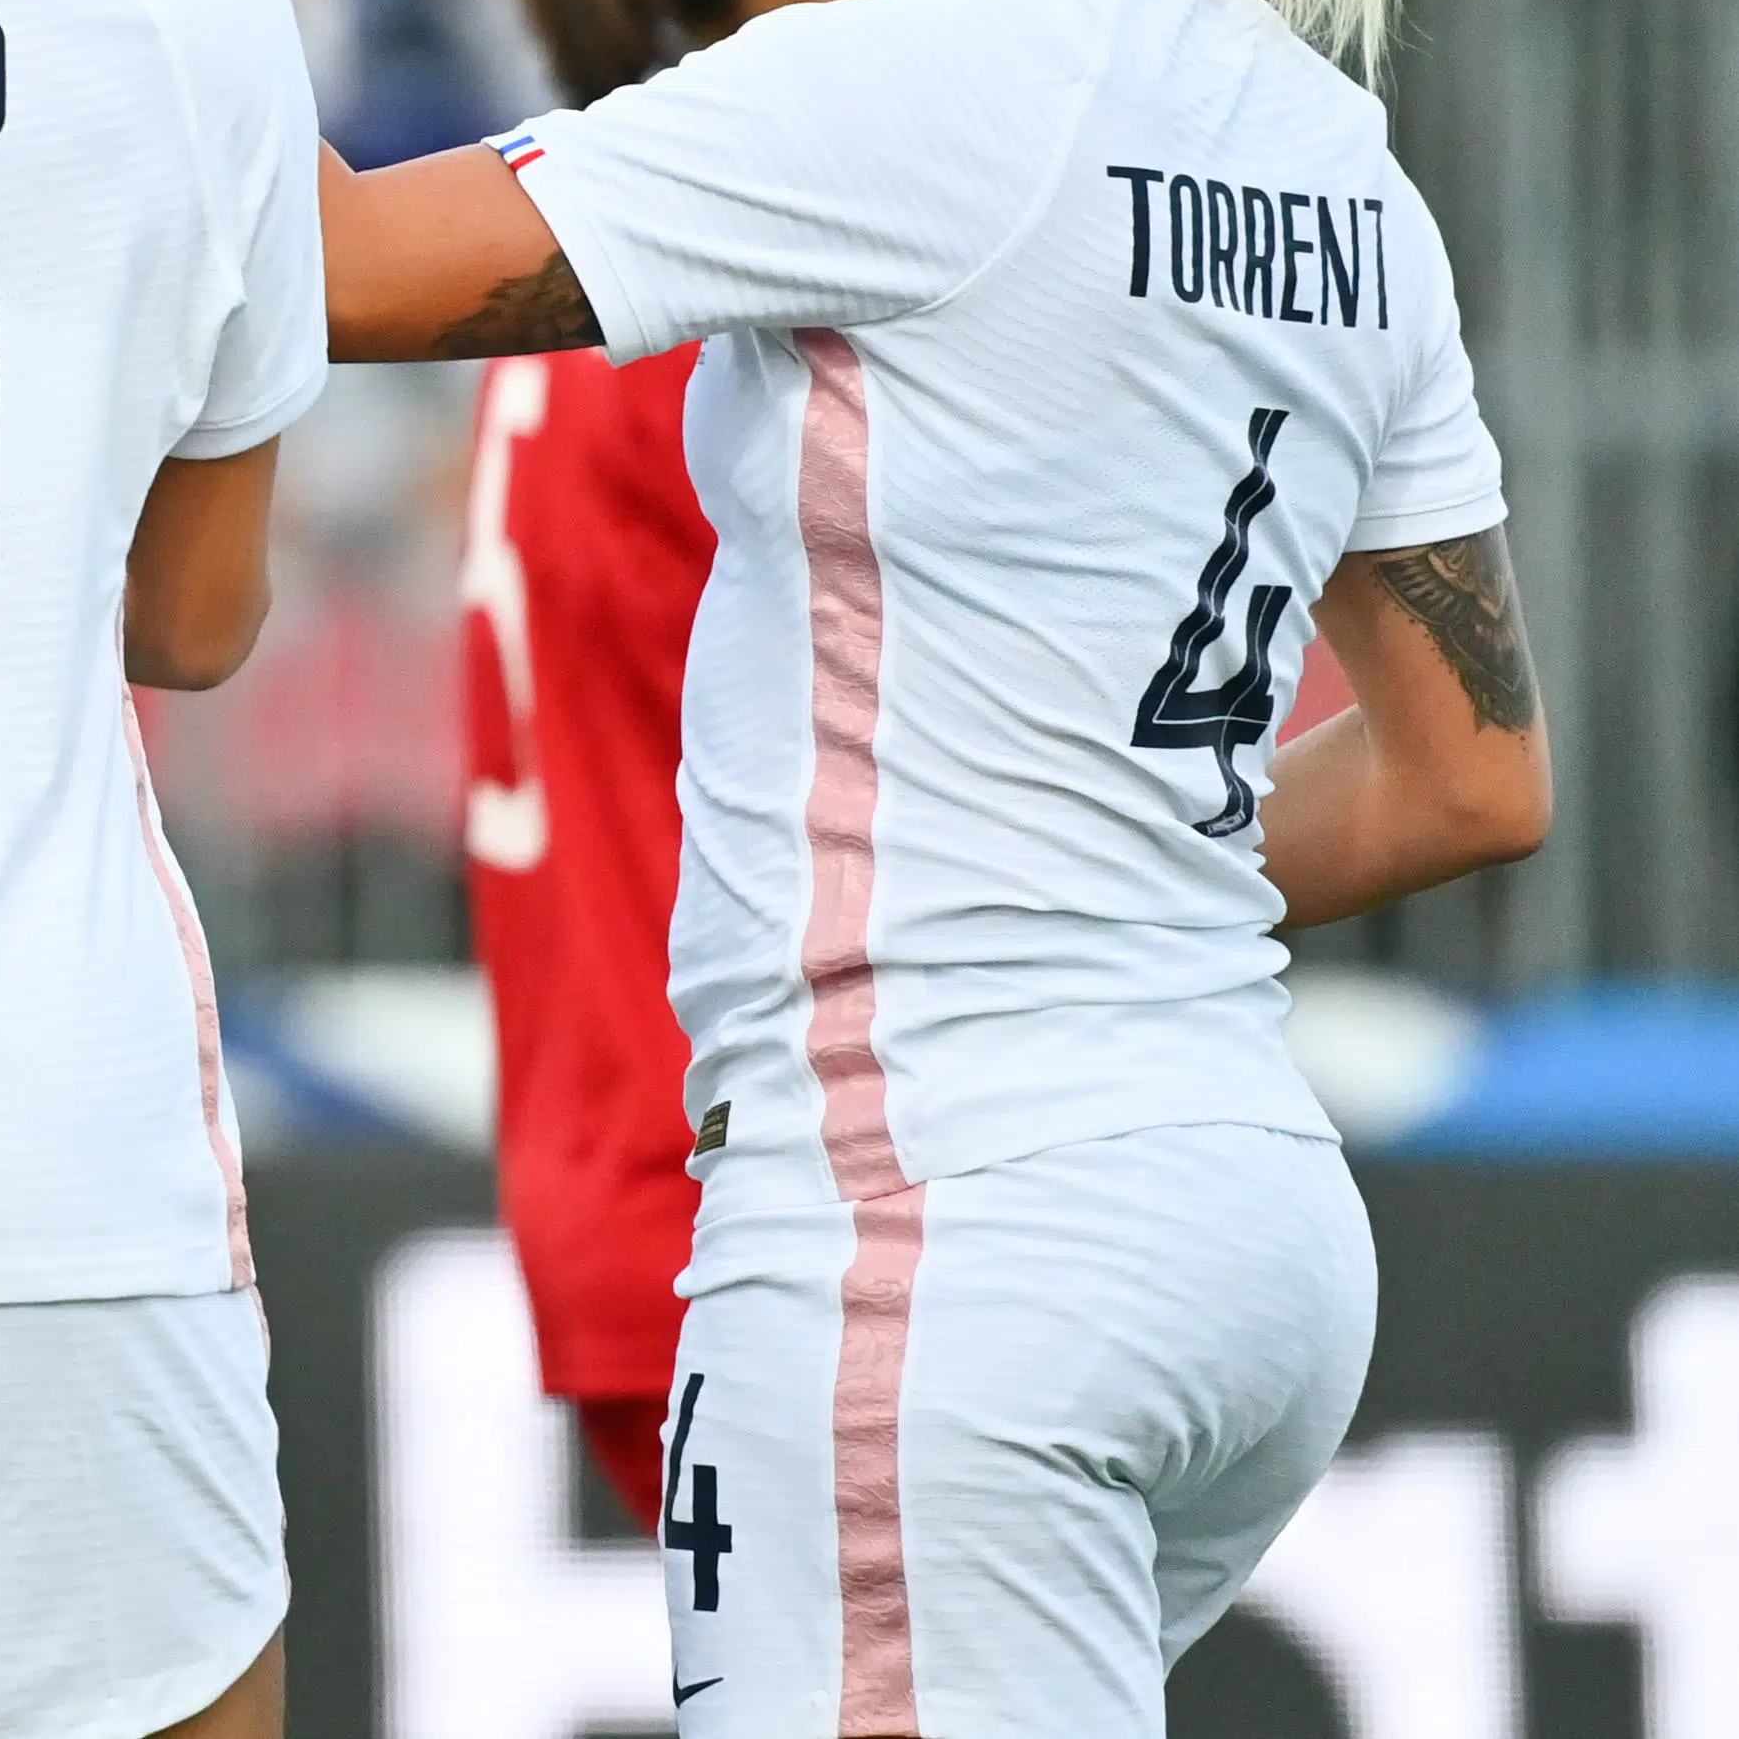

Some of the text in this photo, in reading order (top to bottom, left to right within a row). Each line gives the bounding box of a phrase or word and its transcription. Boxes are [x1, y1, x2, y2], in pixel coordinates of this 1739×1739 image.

[1106, 165, 1389, 330] TORRENT
[1129, 407, 1293, 837] 4
[664, 1372, 733, 1612] 4
